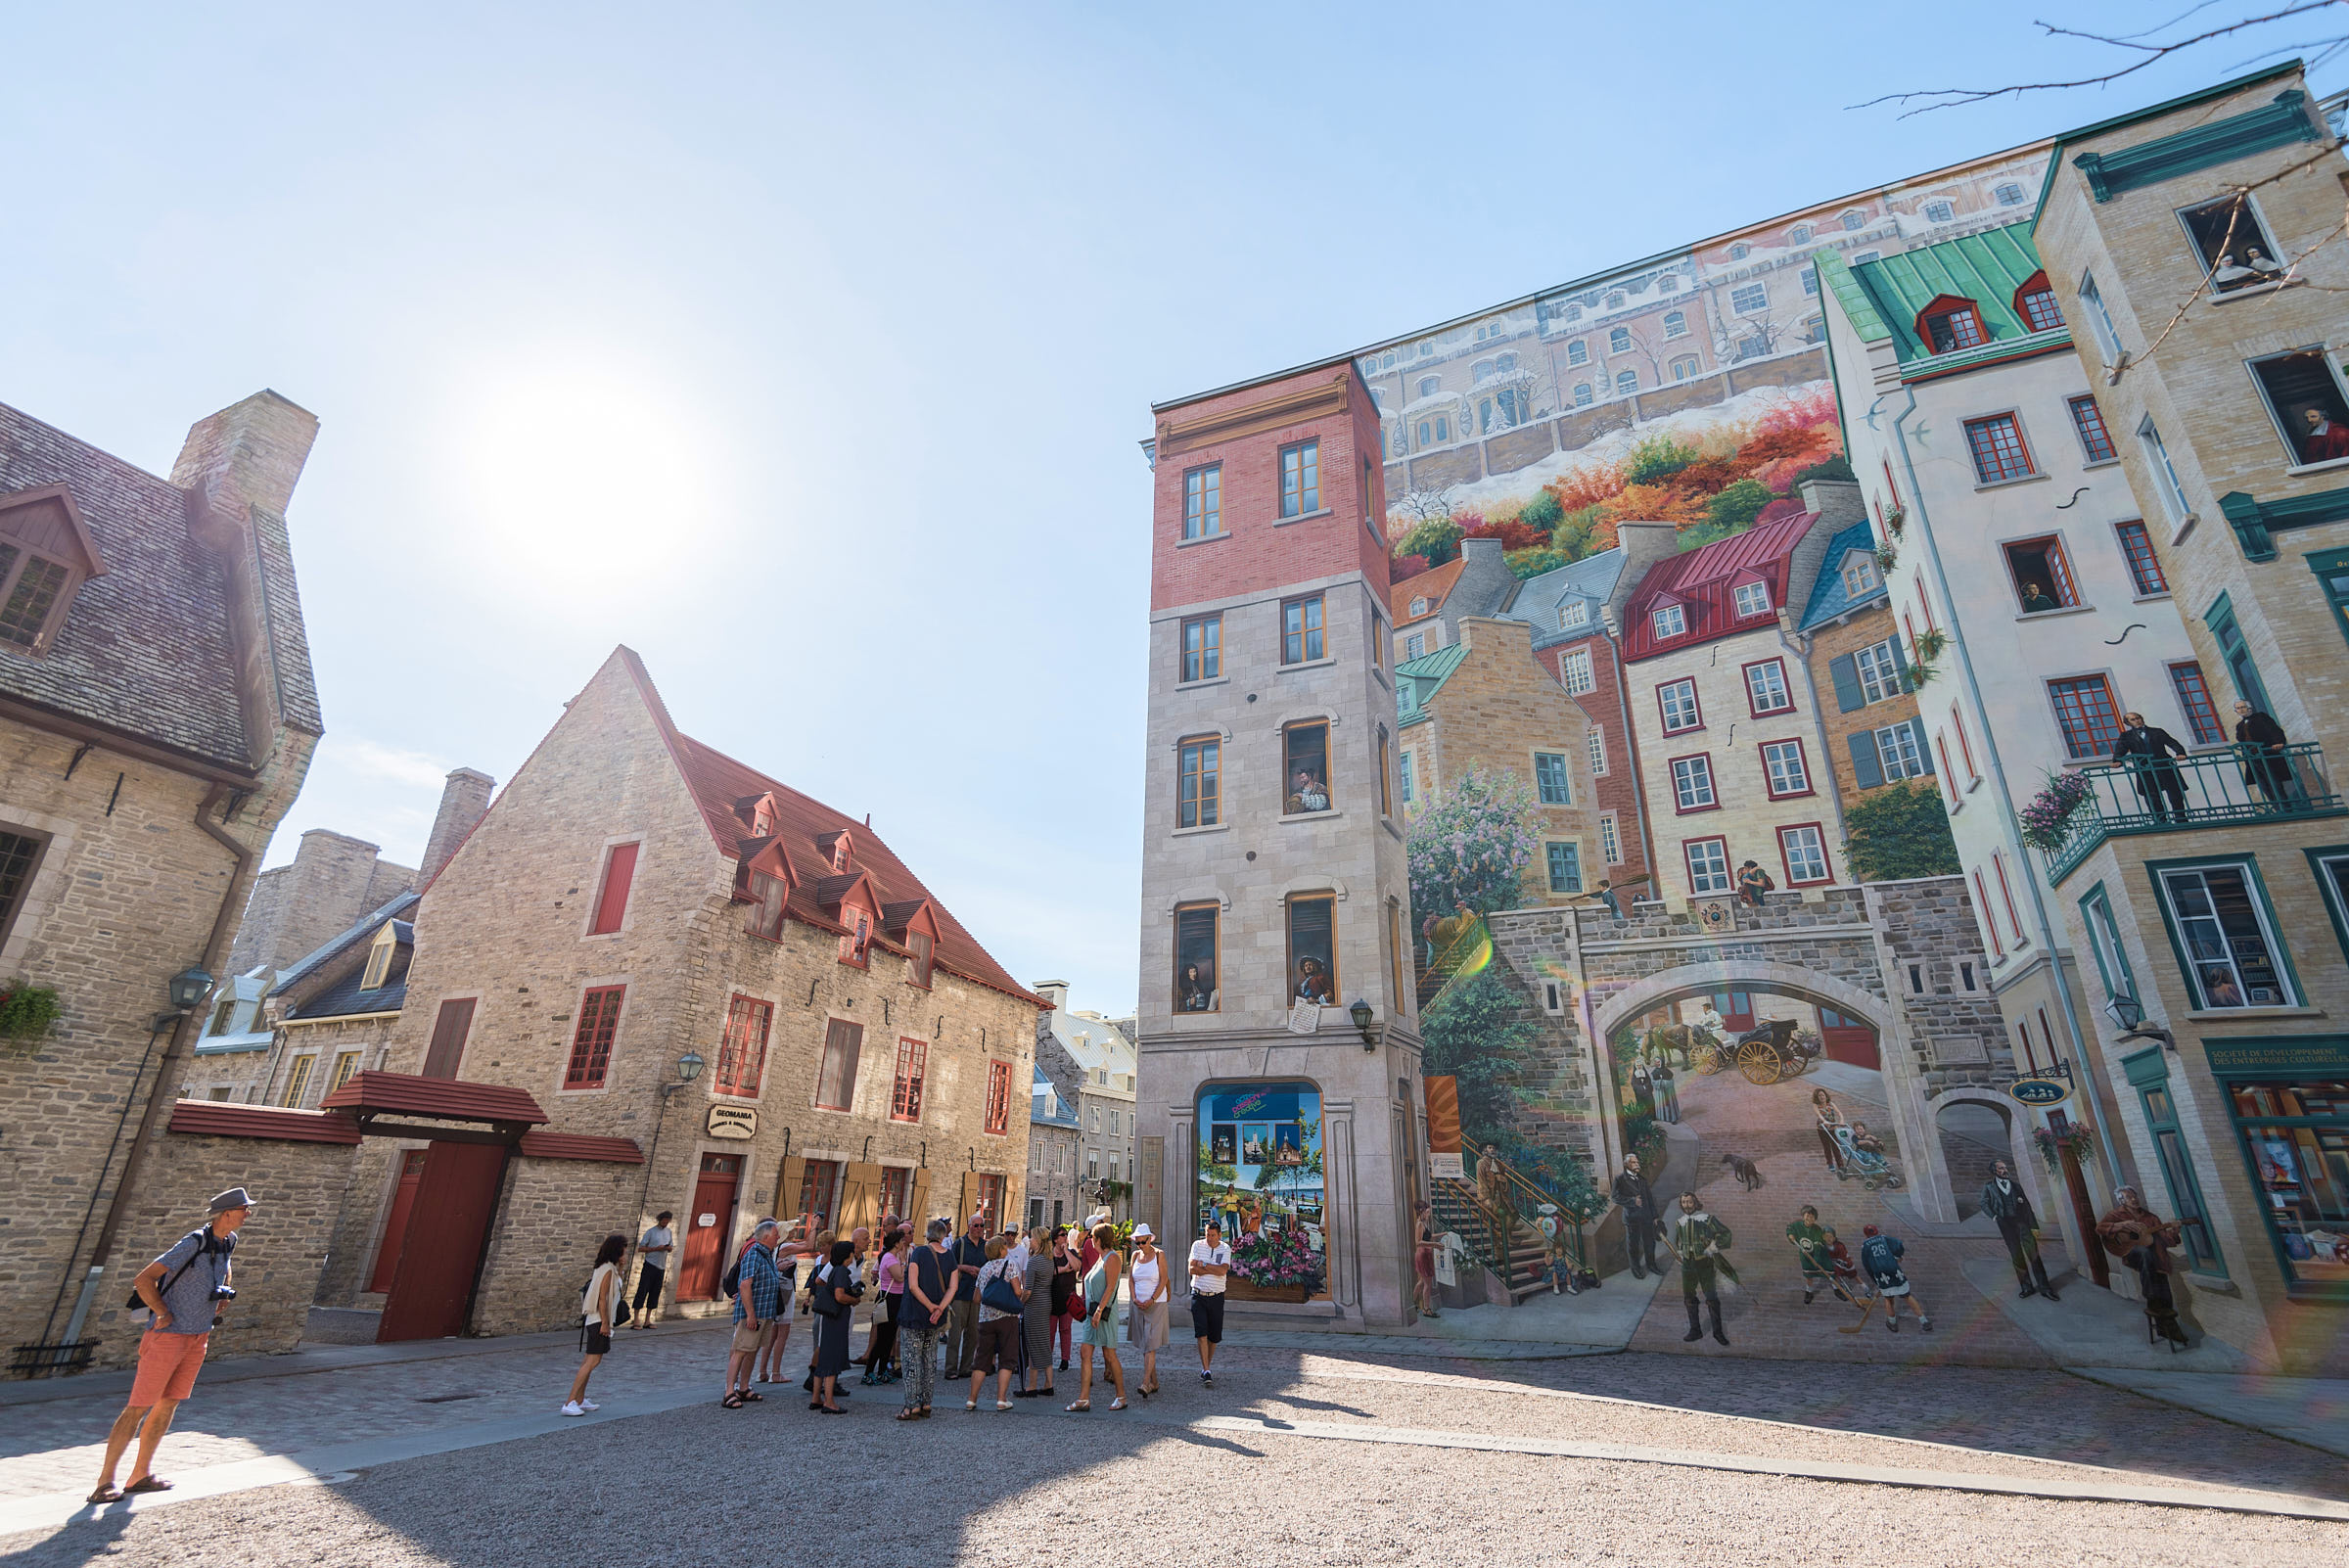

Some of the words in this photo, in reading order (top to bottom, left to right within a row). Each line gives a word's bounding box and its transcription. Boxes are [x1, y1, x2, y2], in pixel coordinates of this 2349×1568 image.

[2249, 1048, 2261, 1057] DE
[2213, 1057, 2231, 1066] DES
[2232, 1056, 2287, 1065] ENTREPRISES
[2289, 1054, 2349, 1064] CULTURELLES
[716, 1109, 753, 1120] GEOMANIA
[1870, 1244, 1887, 1257] 26
